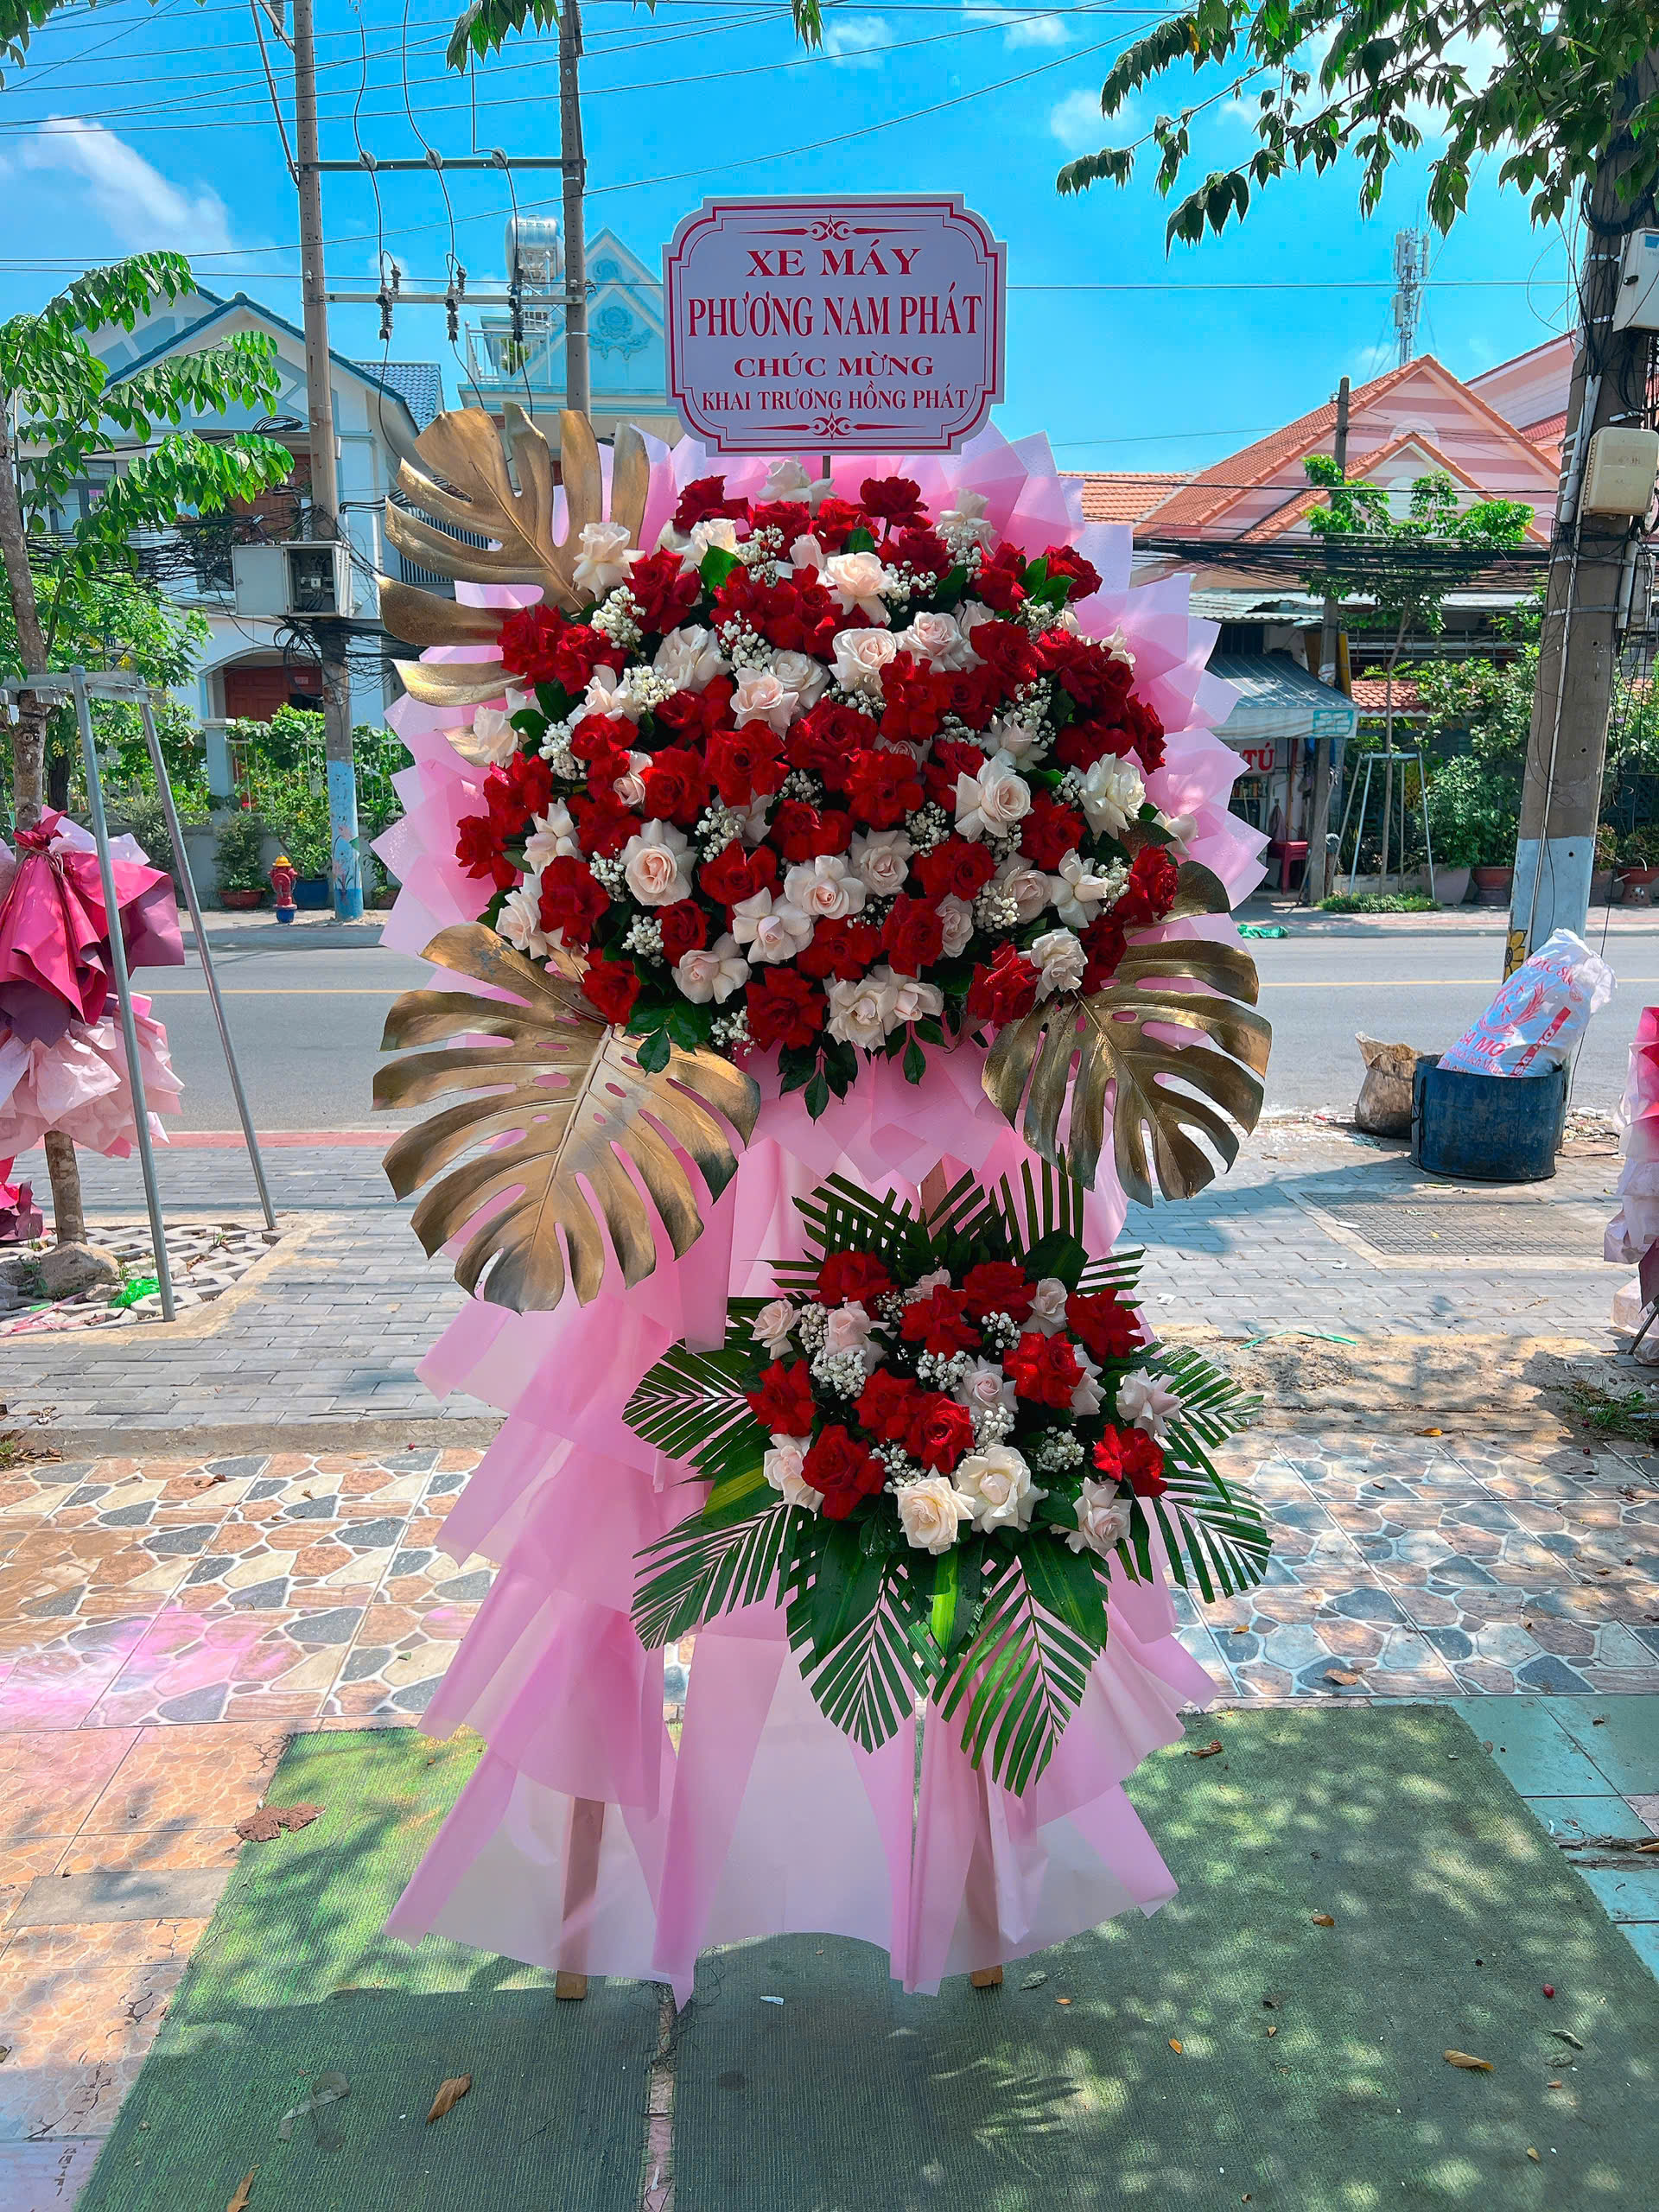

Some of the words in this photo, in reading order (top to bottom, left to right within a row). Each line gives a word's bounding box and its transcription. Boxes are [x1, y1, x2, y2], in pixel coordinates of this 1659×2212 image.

[746, 249, 805, 276] XE
[819, 238, 922, 276] MÁY
[688, 291, 813, 338] PHƯƠNG
[823, 296, 891, 336] NAM
[899, 281, 982, 334] PHÁT
[734, 351, 827, 378] CHÚC
[838, 350, 933, 378] MỪNG
[702, 391, 751, 411] KHAI
[757, 388, 842, 410] TRƯƠNG
[849, 380, 906, 410] HỒNG
[913, 383, 969, 409] PHÁT
[1242, 741, 1275, 771] TÚ
